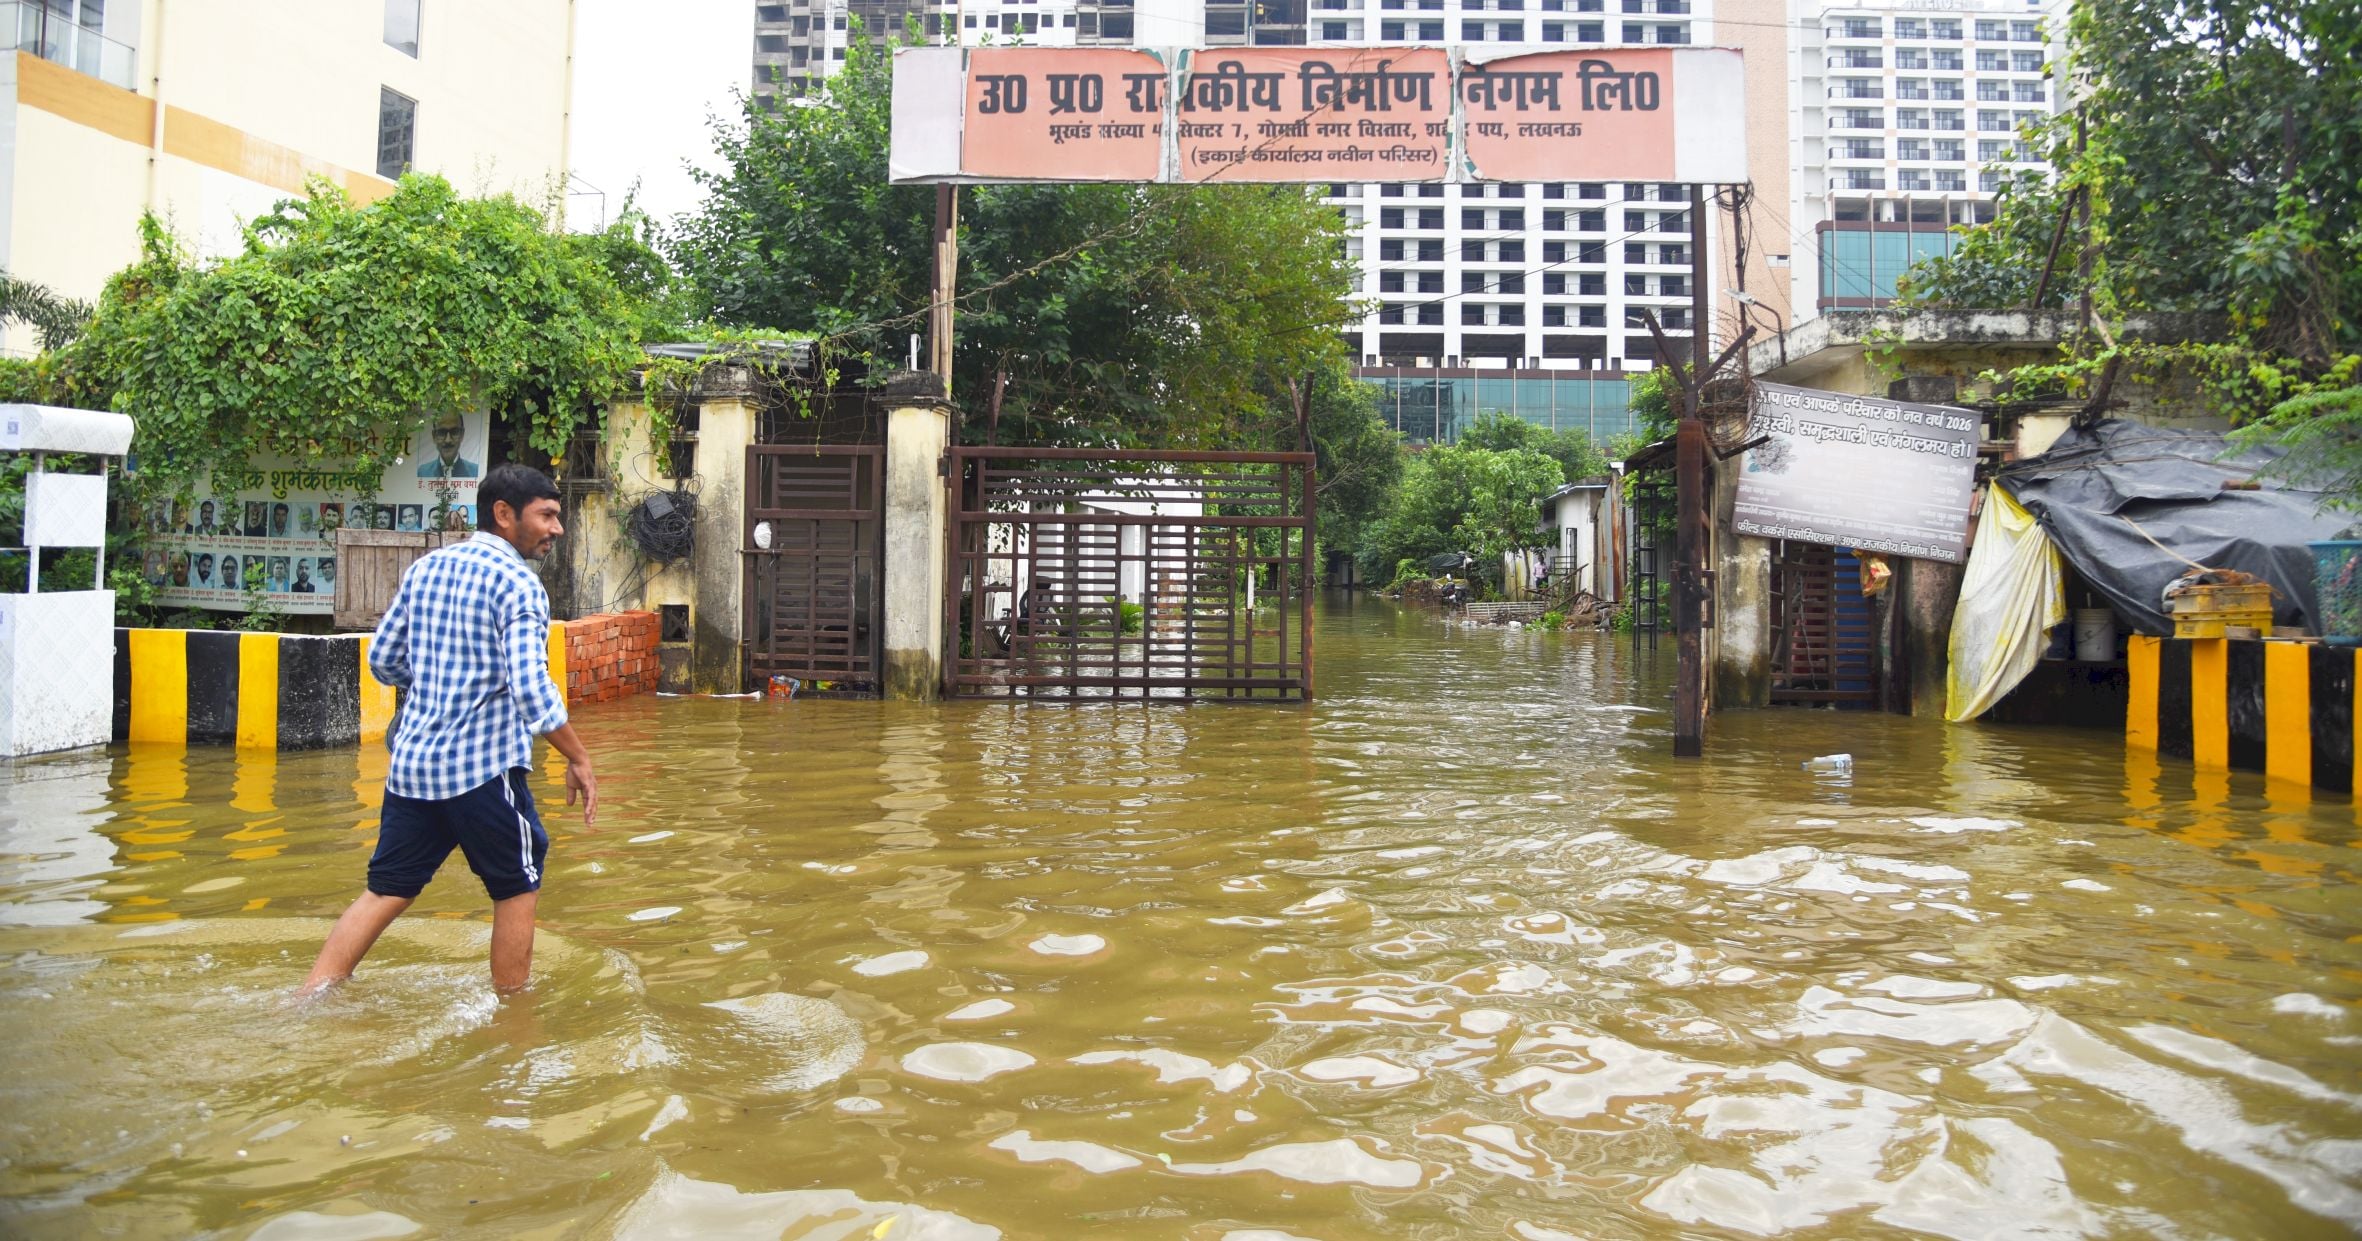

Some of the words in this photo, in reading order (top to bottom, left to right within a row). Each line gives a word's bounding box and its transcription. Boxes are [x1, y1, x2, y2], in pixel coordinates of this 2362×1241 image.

[1122, 60, 1285, 114] राकीय
[1297, 59, 1434, 112] निर्माण
[1049, 119, 1091, 144] भूखंड
[1099, 119, 1144, 139] संख्या
[1178, 119, 1224, 138] सेक्टर
[1232, 124, 1249, 141] 7,
[1316, 122, 1352, 138] नगर
[1358, 118, 1417, 141] विस्तार,
[1476, 122, 1509, 140] पथ,
[1517, 122, 1583, 138] लखनऊ
[1191, 145, 1247, 167] (इकाई
[1250, 145, 1323, 163] कार्यालय
[1327, 144, 1374, 162] नवीन
[1378, 144, 1438, 166] परिसर)
[1783, 391, 1803, 408] एवं
[1802, 397, 1841, 413] आपके
[1843, 398, 1882, 420] परिवार
[1883, 404, 1901, 422] को
[1903, 410, 1924, 425] नव
[1925, 410, 1945, 428] वर्ष
[1945, 416, 1973, 432] 2026
[1870, 428, 1892, 446] एवं
[1891, 430, 1949, 455] मंगलमय
[1737, 518, 1761, 534] फील्ड
[1863, 538, 1899, 553] राजकीय
[1900, 541, 1929, 557] निर्माण
[1930, 544, 1956, 561] निगम
